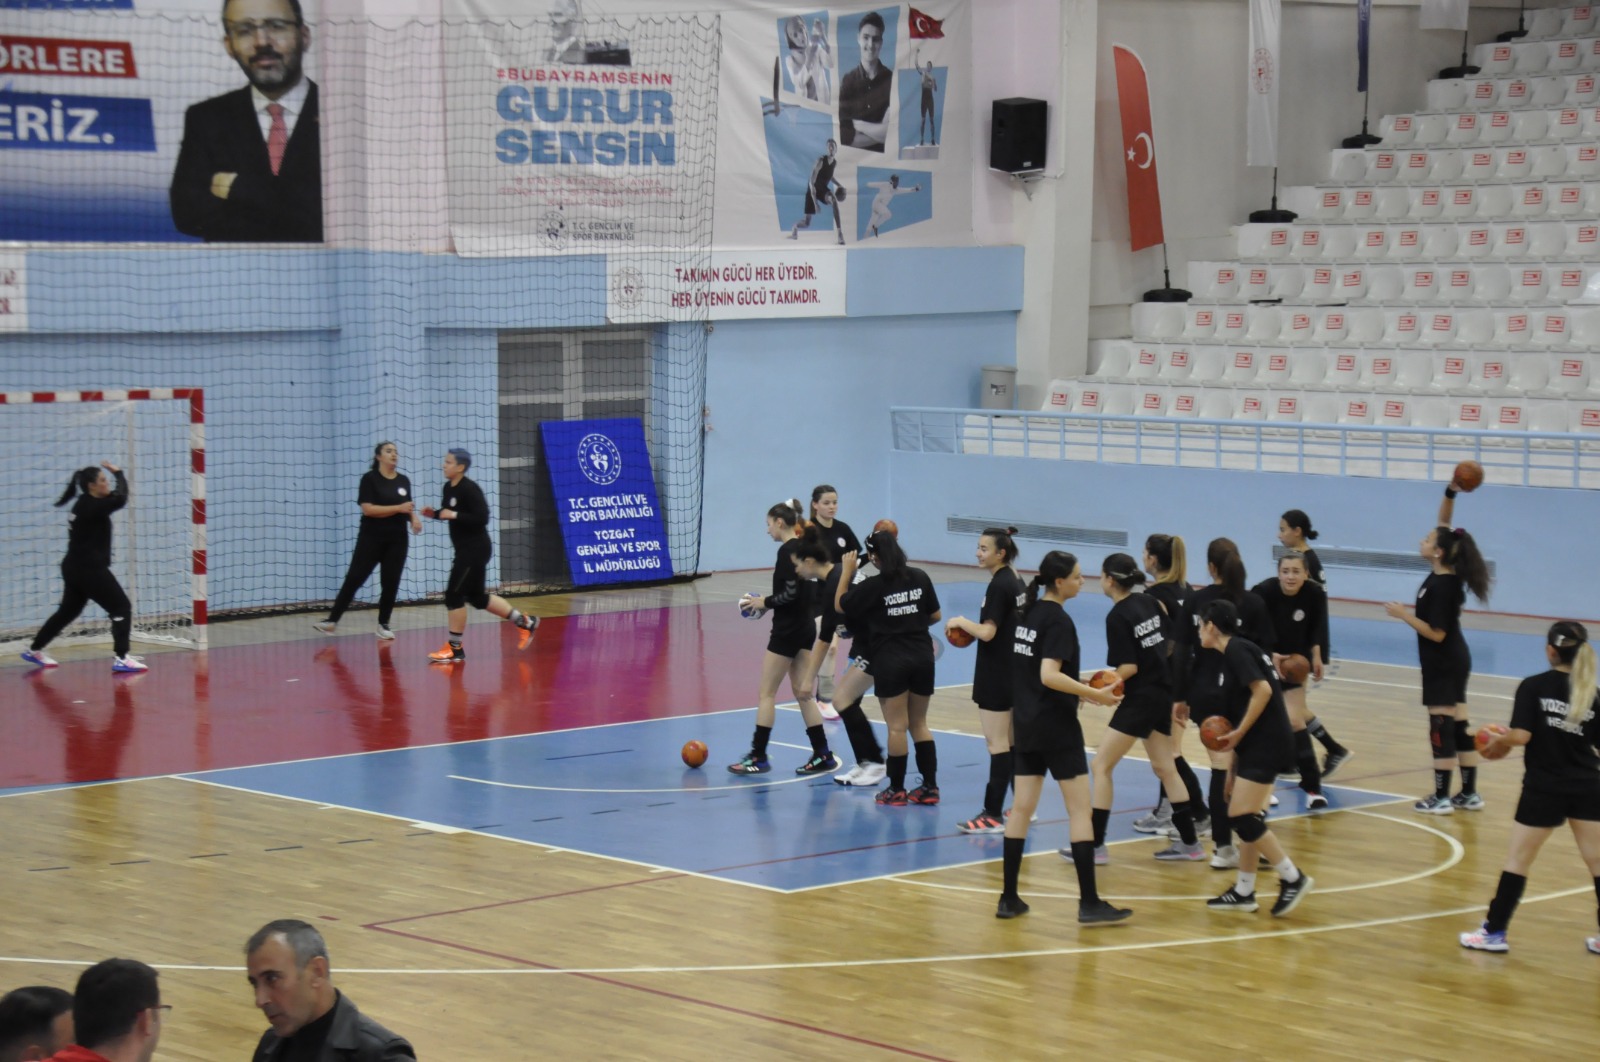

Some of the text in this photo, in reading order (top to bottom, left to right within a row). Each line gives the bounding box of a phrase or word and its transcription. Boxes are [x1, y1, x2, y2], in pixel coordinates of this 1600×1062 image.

[496, 85, 673, 125] GURUR
[624, 222, 635, 231] VE
[572, 233, 592, 241] SPOR
[675, 262, 817, 283] TAKIMIN GÜCÜ HER ÜYEDİR.
[672, 287, 821, 307] HER ÜYENİN GÜCÜ TAKIMDIR.
[568, 493, 648, 510] T.C. GENÇLİK VE
[568, 505, 653, 523] SPOR BAKANLIĞI
[594, 528, 635, 541] YOZGAT
[576, 540, 661, 557] GENÇLİK VE SPOR
[583, 555, 661, 574] İL MÜDÜRLÜĞÜ
[884, 588, 923, 606] YOZGAT ASP
[887, 604, 918, 616] HENTBOL
